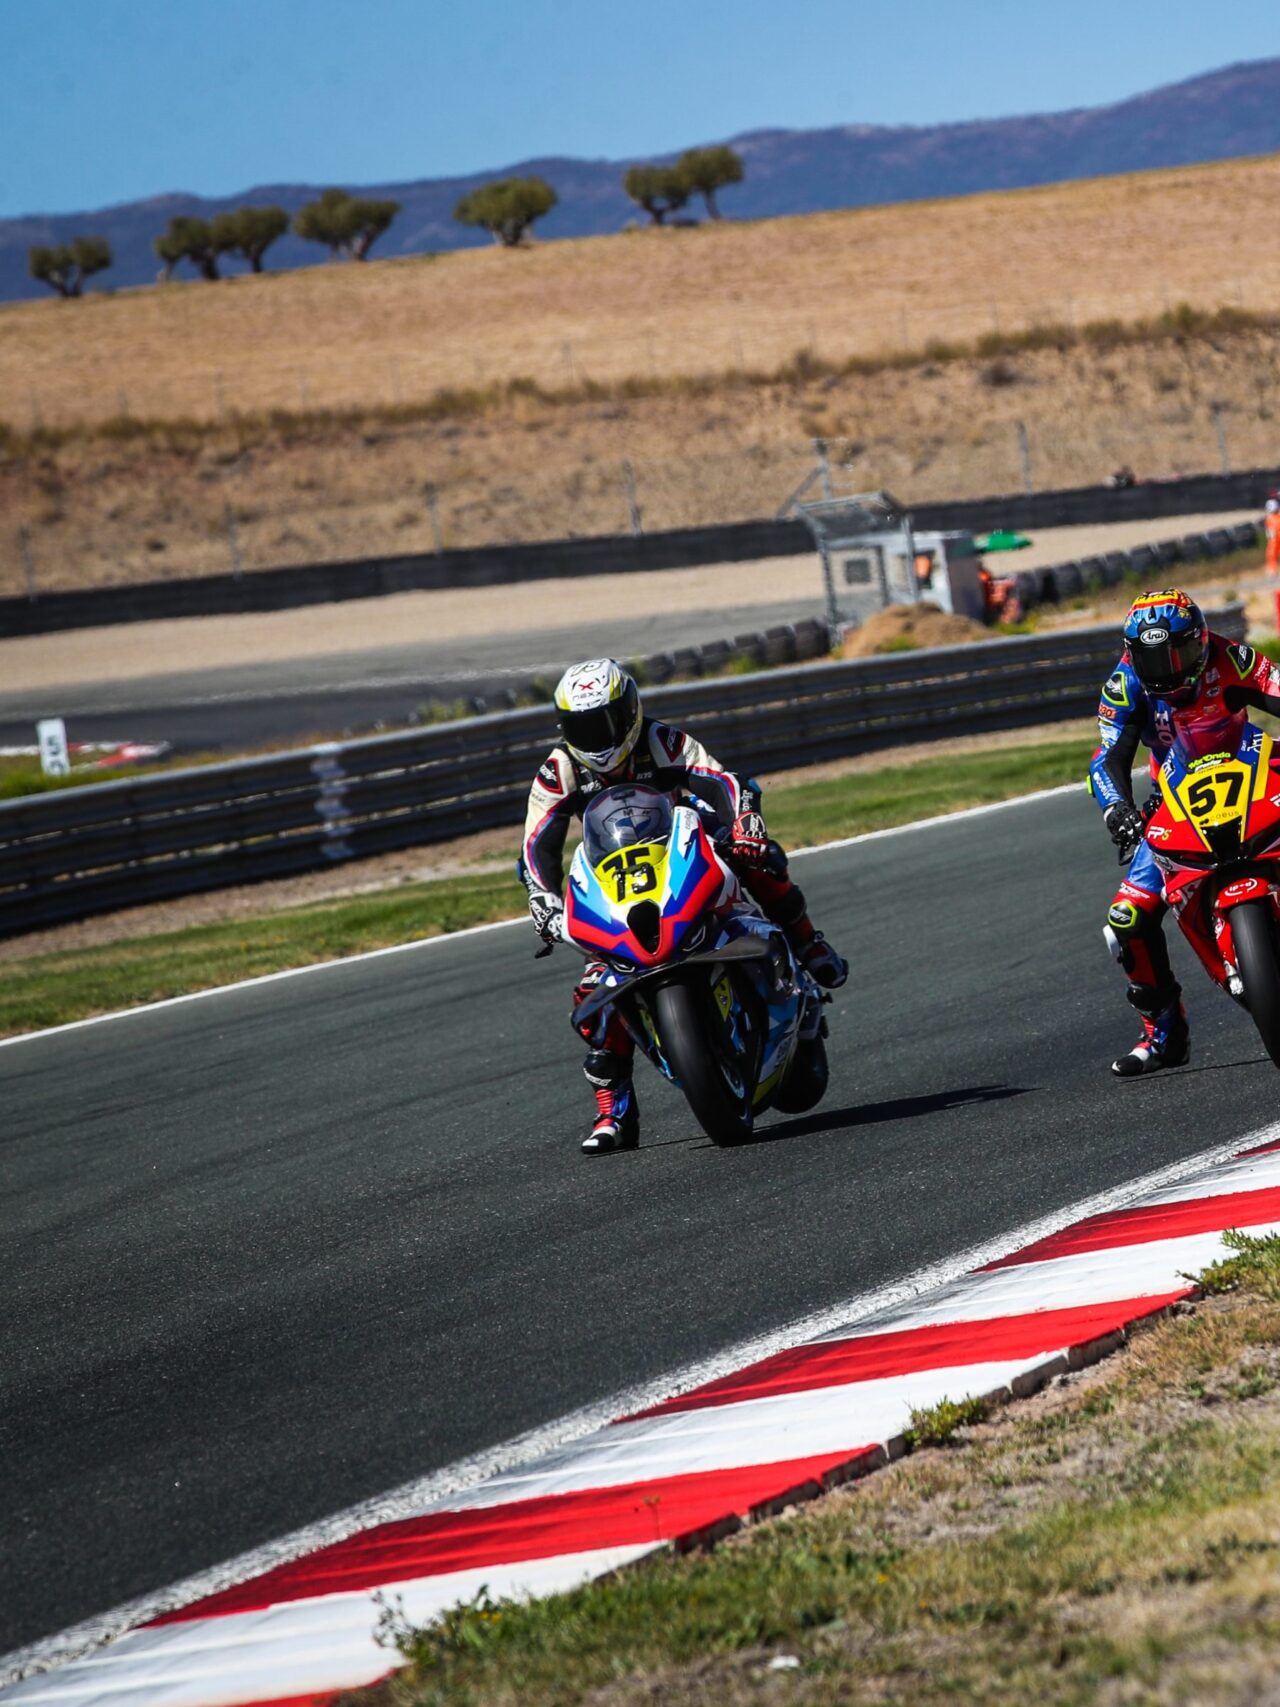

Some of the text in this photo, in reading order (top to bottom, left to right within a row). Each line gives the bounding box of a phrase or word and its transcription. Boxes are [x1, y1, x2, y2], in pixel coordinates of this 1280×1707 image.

[1146, 631, 1164, 641] Arai
[1188, 772, 1244, 817] 57
[602, 847, 657, 902] 75
